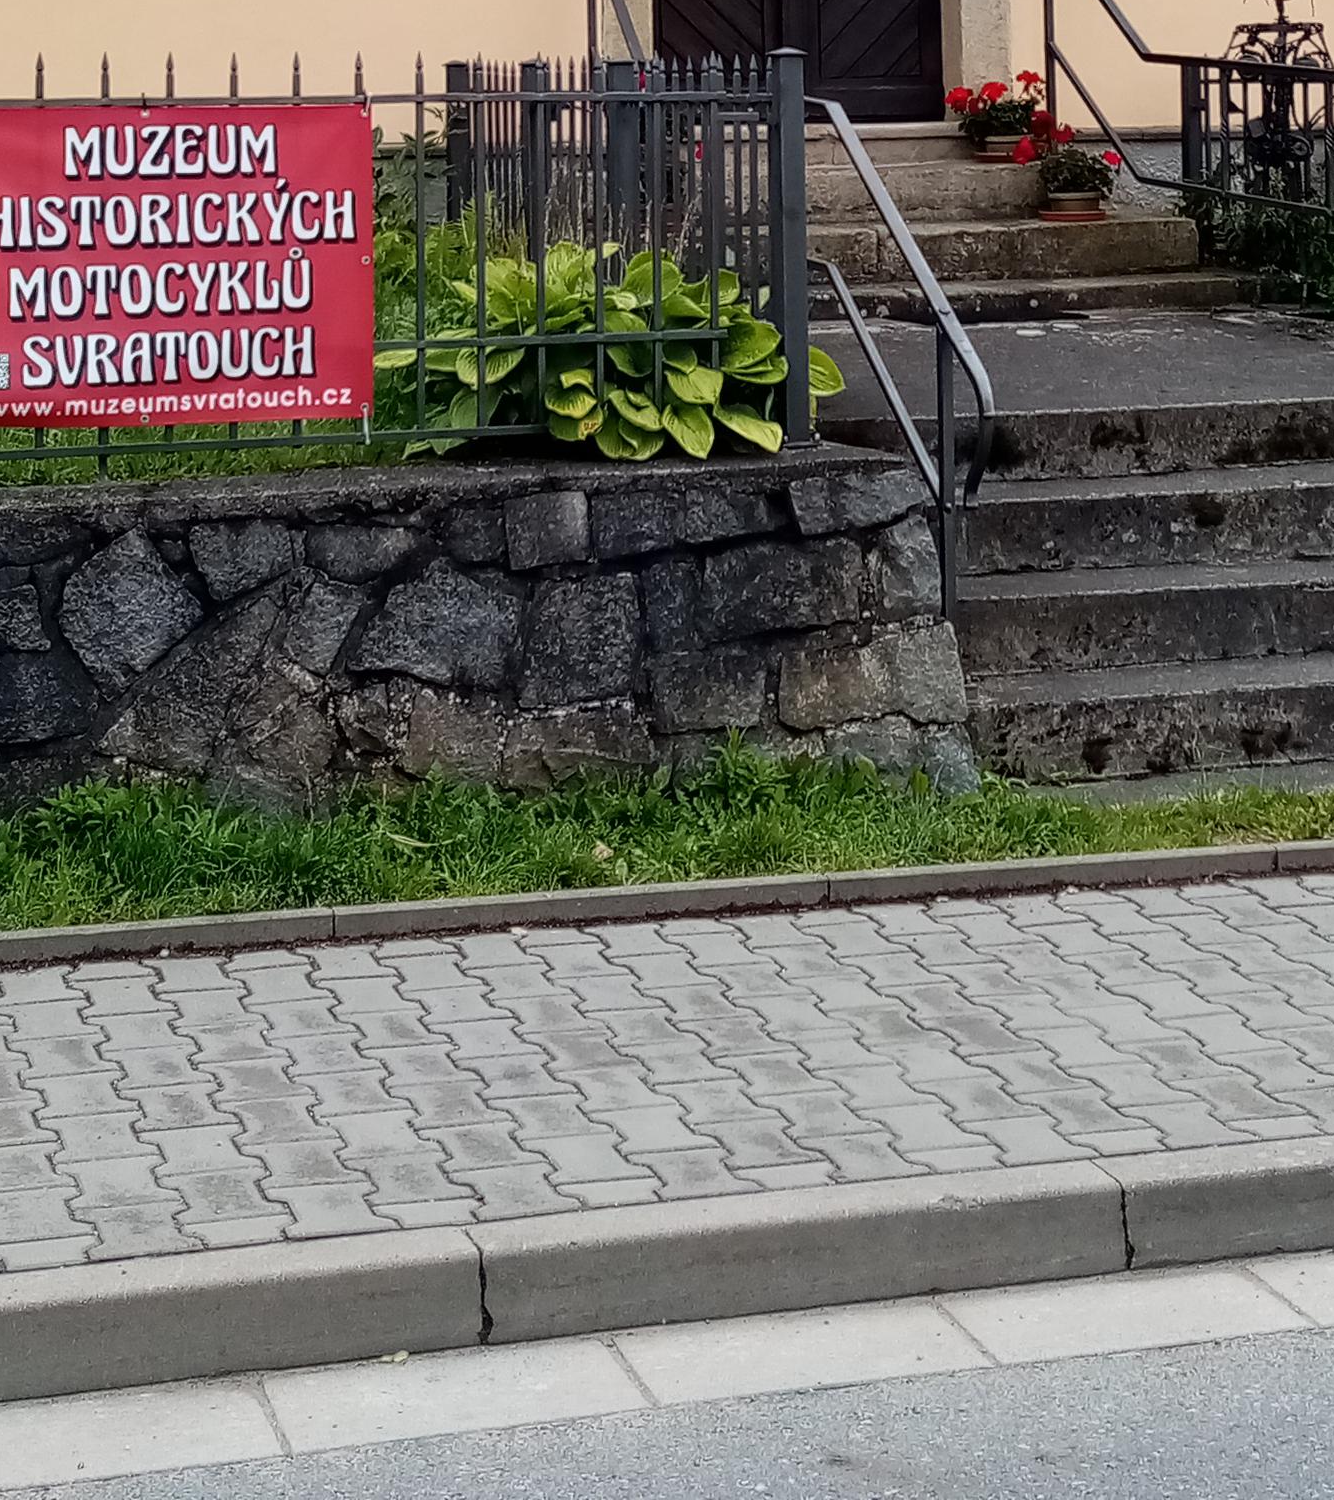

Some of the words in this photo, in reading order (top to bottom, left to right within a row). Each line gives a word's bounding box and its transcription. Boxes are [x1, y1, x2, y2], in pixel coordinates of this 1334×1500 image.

[63, 124, 278, 178] MUZEUM
[8, 246, 313, 320] MOTOCYKLŮ
[21, 325, 317, 389] SVRATOUCH
